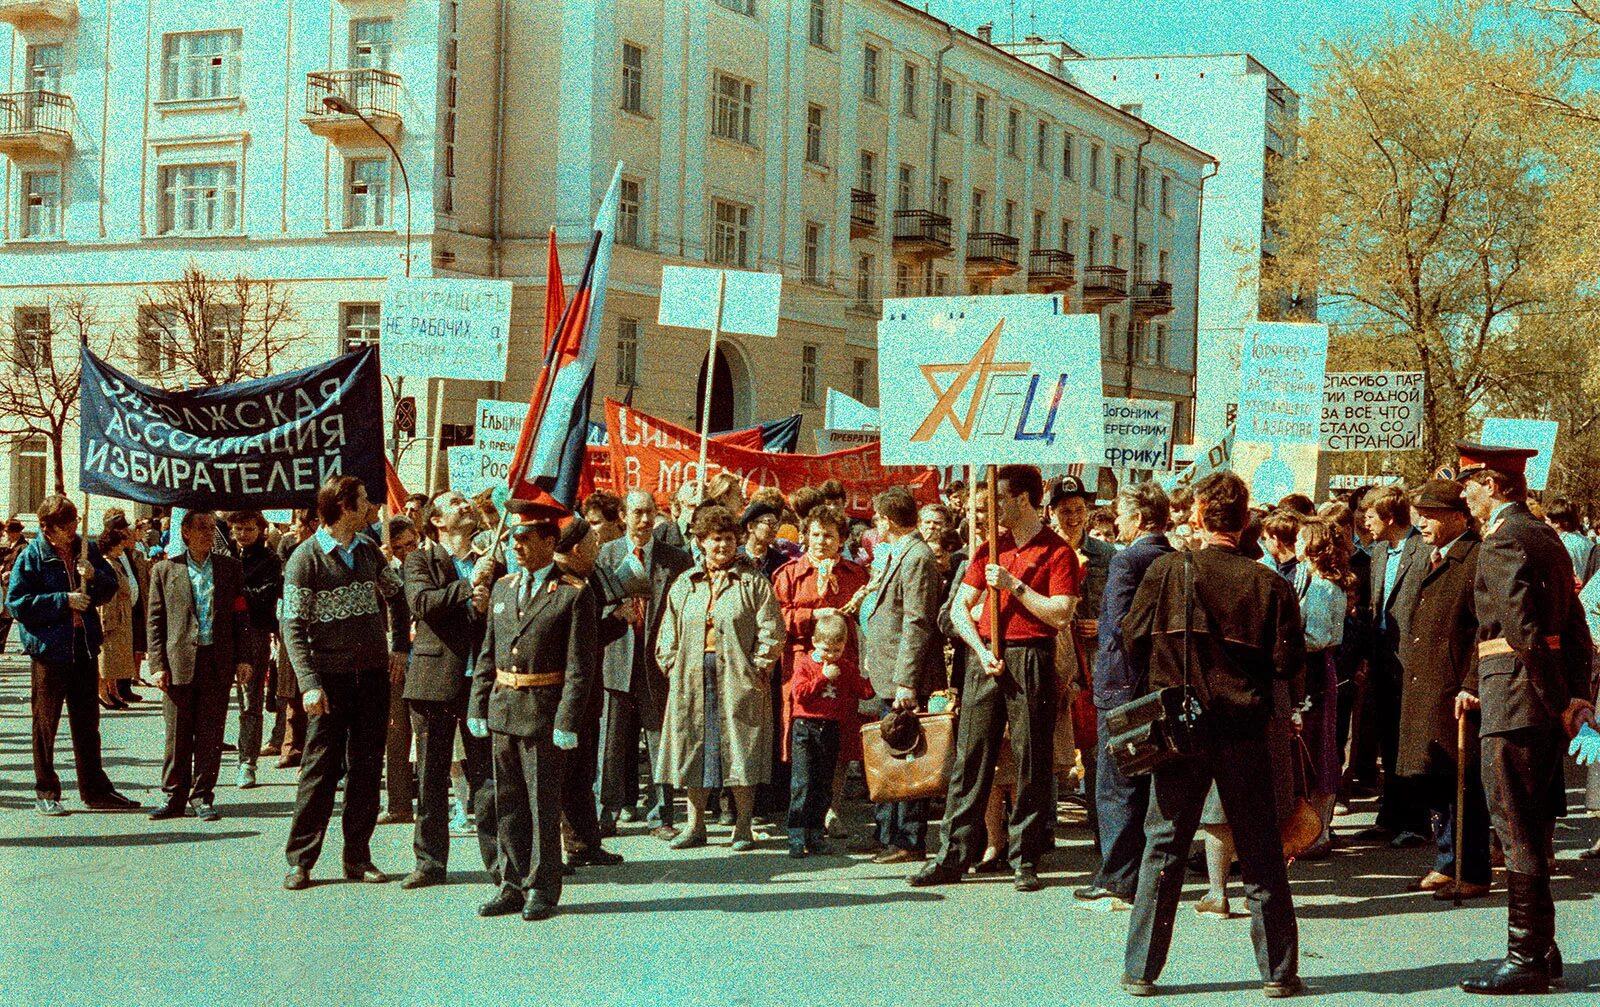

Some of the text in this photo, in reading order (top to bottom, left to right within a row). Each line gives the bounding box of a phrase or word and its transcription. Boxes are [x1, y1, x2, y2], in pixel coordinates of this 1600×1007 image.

[385, 316, 404, 336] НЕ
[1324, 375, 1388, 388] СПАСИБО
[1354, 387, 1420, 403] РОДНОЙ
[481, 408, 526, 432] Ельцин
[1321, 407, 1339, 420] ЗА
[1378, 405, 1410, 420] ЧТО
[104, 408, 347, 459] АССОЦИАЦИЯ
[1104, 424, 1167, 437] ЕРЕГОНИМ
[1320, 420, 1404, 435] СТАЛО СО
[1105, 441, 1168, 467] фрику!
[83, 439, 343, 494] ИЗБИРАТЕЛЕЙ
[481, 454, 508, 480] Рос
